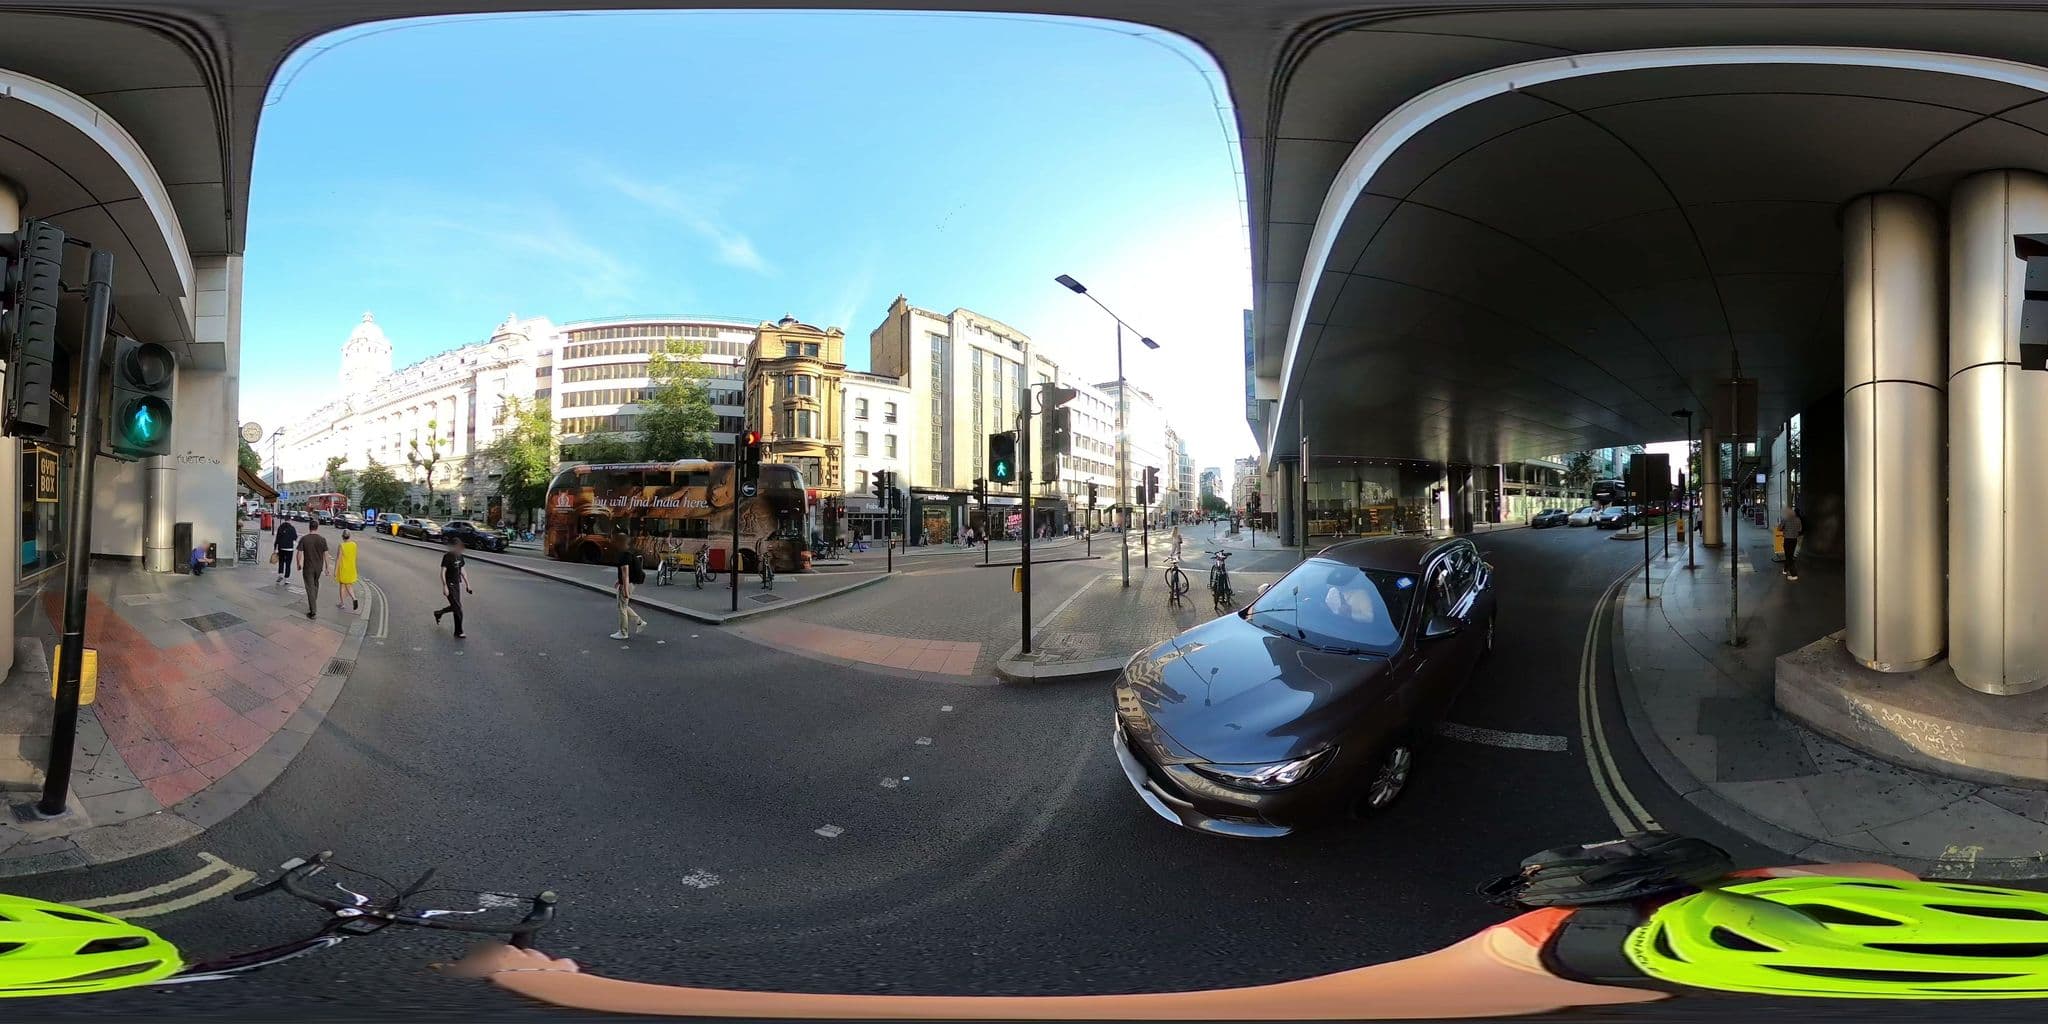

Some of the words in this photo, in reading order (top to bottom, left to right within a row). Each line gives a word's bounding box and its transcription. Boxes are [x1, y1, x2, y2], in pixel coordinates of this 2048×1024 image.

[41, 458, 56, 475] GYM
[41, 475, 55, 493] BOX
[610, 495, 628, 507] will
[629, 495, 650, 509] find
[653, 495, 680, 508] India
[683, 496, 709, 509] here.
